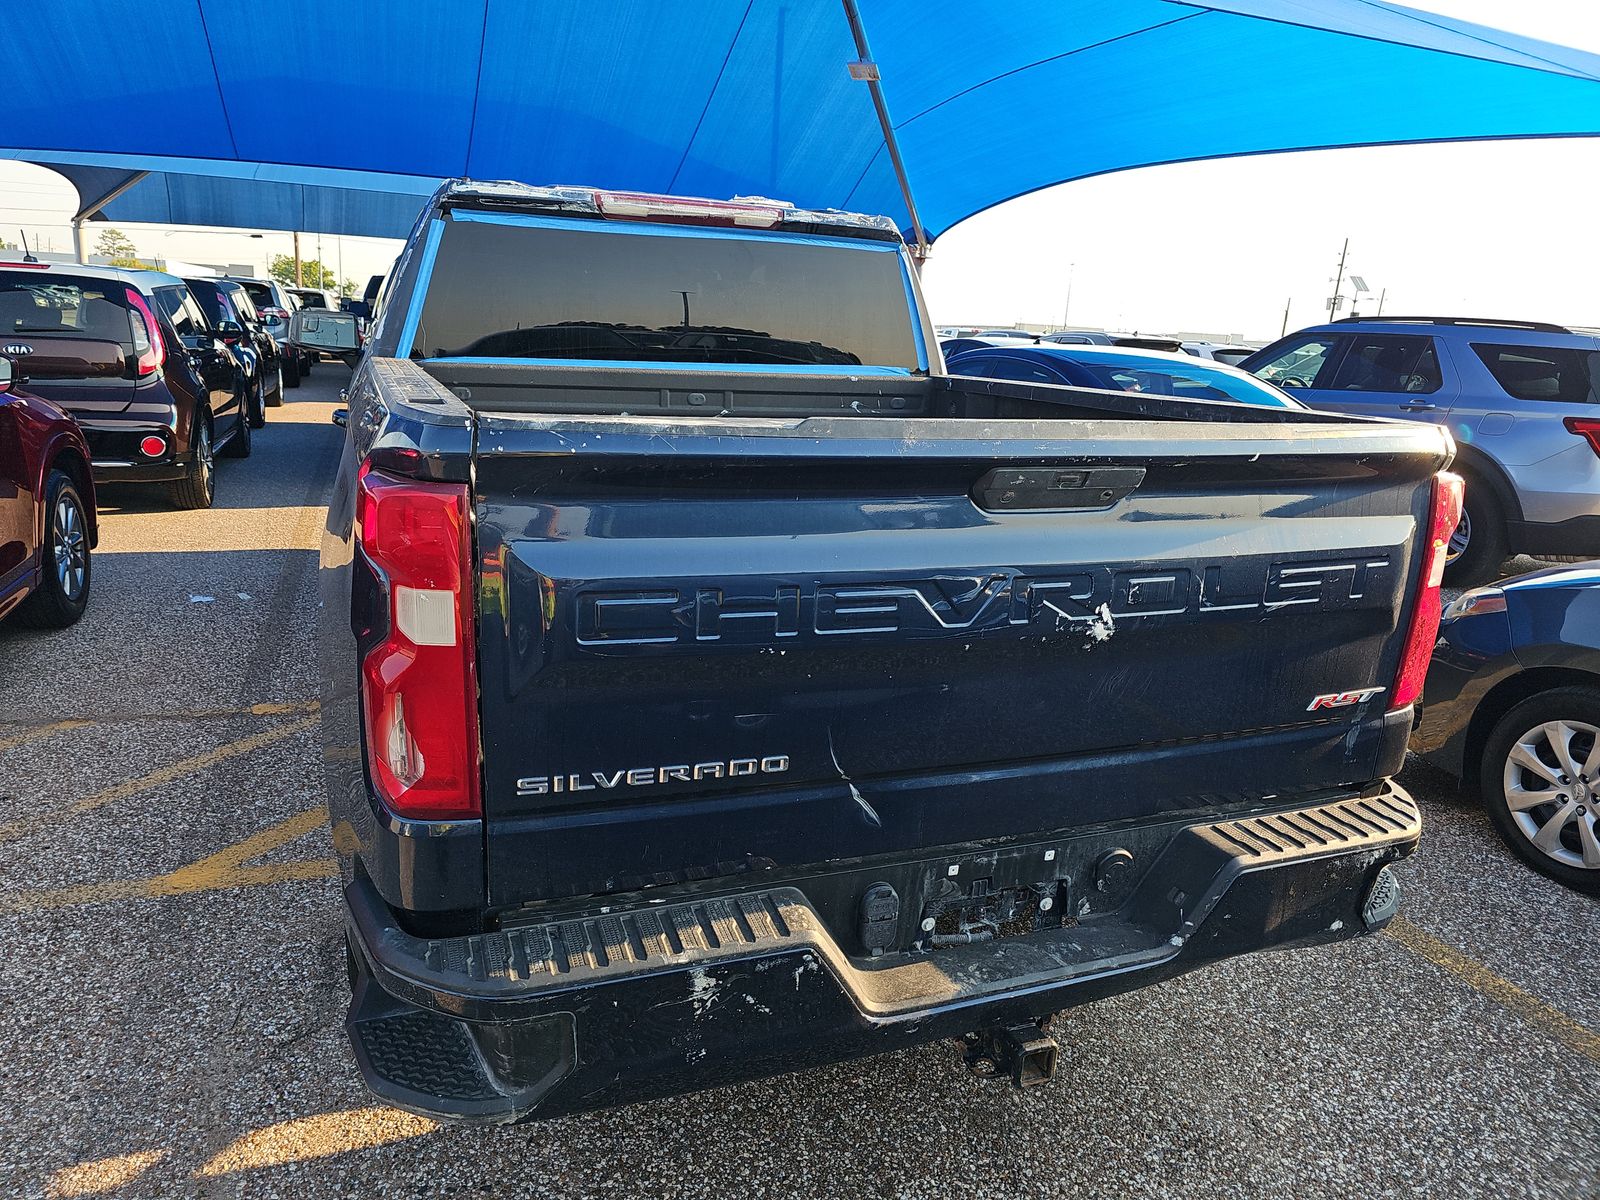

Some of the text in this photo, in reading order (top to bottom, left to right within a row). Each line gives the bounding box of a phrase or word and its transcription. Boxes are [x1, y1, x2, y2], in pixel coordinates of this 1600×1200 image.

[6, 344, 29, 355] KIA
[576, 554, 1391, 646] CHEVROLET
[1306, 686, 1387, 711] RST
[516, 755, 789, 796] SILVERADO
